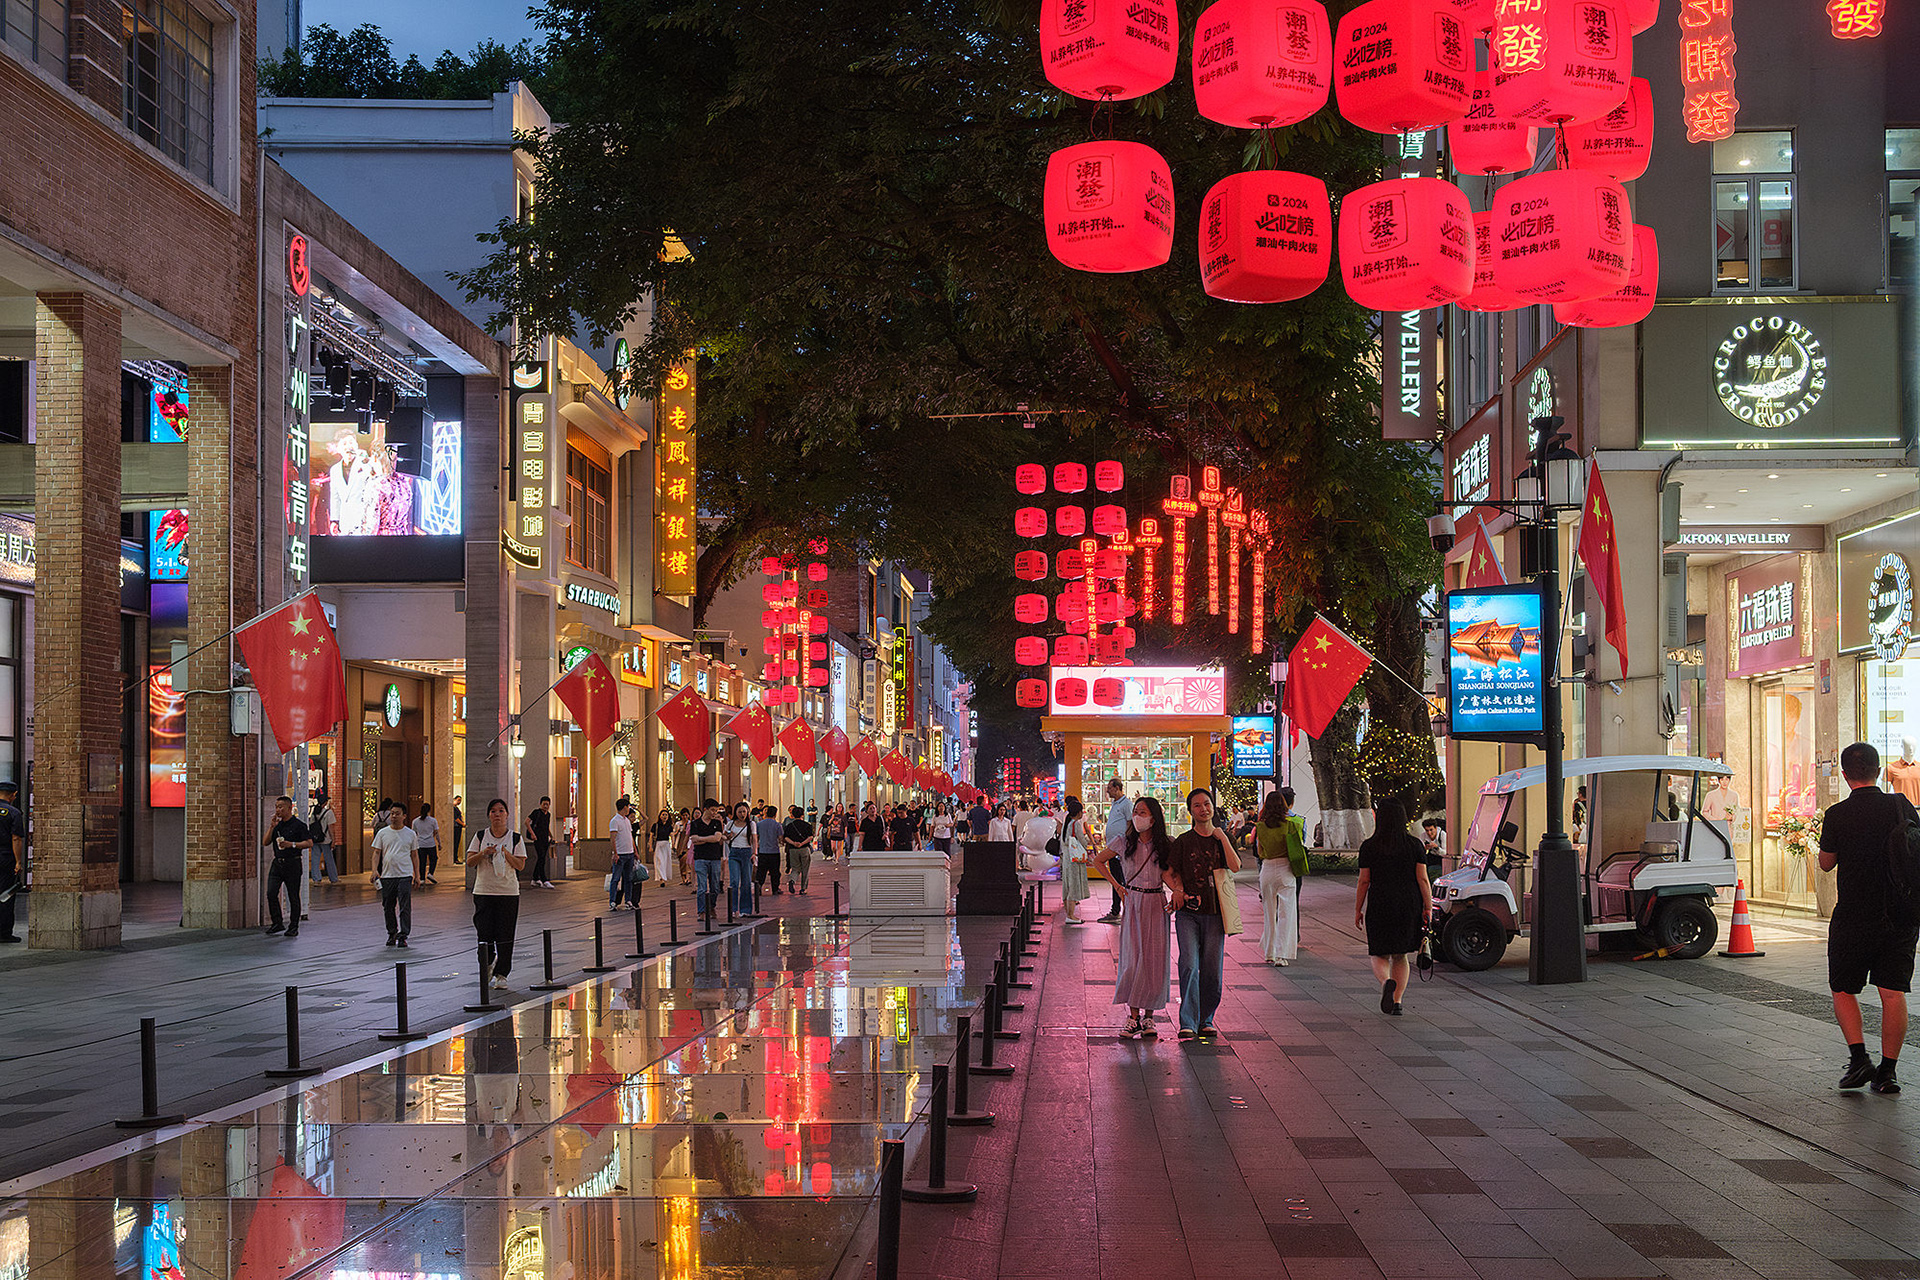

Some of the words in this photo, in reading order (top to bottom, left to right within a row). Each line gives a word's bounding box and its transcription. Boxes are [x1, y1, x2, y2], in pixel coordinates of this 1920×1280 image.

[1064, 0, 1087, 22] 發
[1126, 2, 1168, 34] 必吃榜
[1584, 6, 1610, 46] 潮發
[1364, 22, 1388, 38] 2024
[1198, 37, 1234, 69] 必吃榜
[1343, 39, 1392, 68] 必吃榜
[1464, 103, 1496, 119] 必吃
[1076, 161, 1104, 199] 潮發
[1282, 197, 1308, 210] 2024
[1524, 198, 1549, 212] 2024
[1602, 192, 1622, 232] 潮發
[1255, 212, 1314, 237] 必吃榜
[1368, 200, 1398, 240] 潮發
[1501, 214, 1554, 242] 必吃榜
[1256, 237, 1318, 254] 潮汕牛肉火锅
[1502, 239, 1560, 260] 潮汕牛肉火锅
[1715, 317, 1827, 371] CROCODILE
[1401, 309, 1421, 417] WELLERY
[1746, 354, 1793, 369] 鳄鱼恤
[1718, 378, 1826, 427] CROCODILE
[289, 313, 308, 581] 广州市青年
[523, 403, 543, 536] 青宫电影城
[1453, 434, 1490, 502] 六福珠寶
[667, 405, 690, 576] 老鳳祥銀樓
[1677, 534, 1723, 544] UKFOOK
[1725, 534, 1791, 545] JEWELLERY
[1740, 581, 1793, 634] 六福珠寶
[1458, 682, 1494, 690] SHANGHAI
[1496, 682, 1534, 690] SONGJIANG
[1463, 667, 1530, 682] 上海松江
